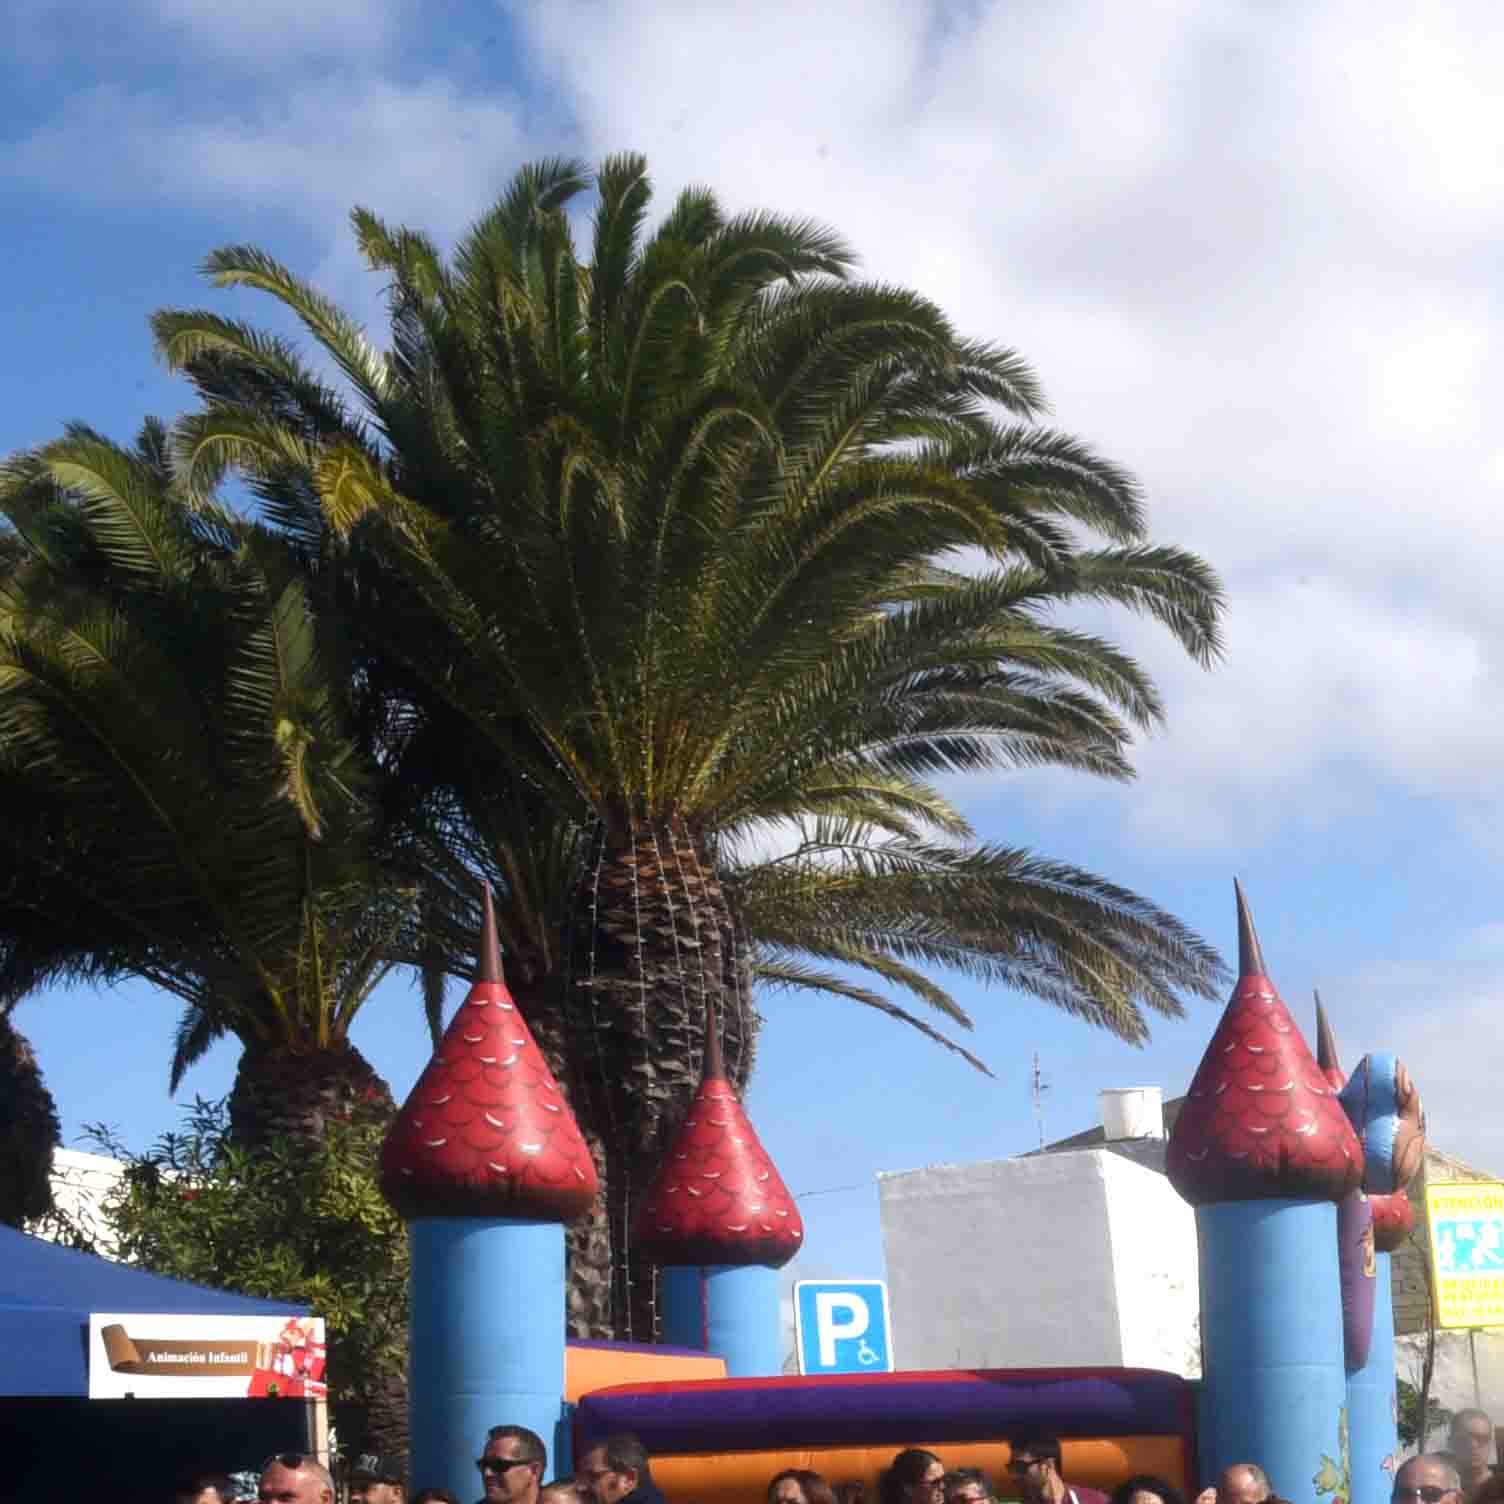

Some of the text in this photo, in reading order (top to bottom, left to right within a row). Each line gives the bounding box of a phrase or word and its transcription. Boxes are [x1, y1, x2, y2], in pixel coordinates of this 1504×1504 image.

[816, 1292, 869, 1367] P
[147, 1351, 248, 1364] Animación Infantil
